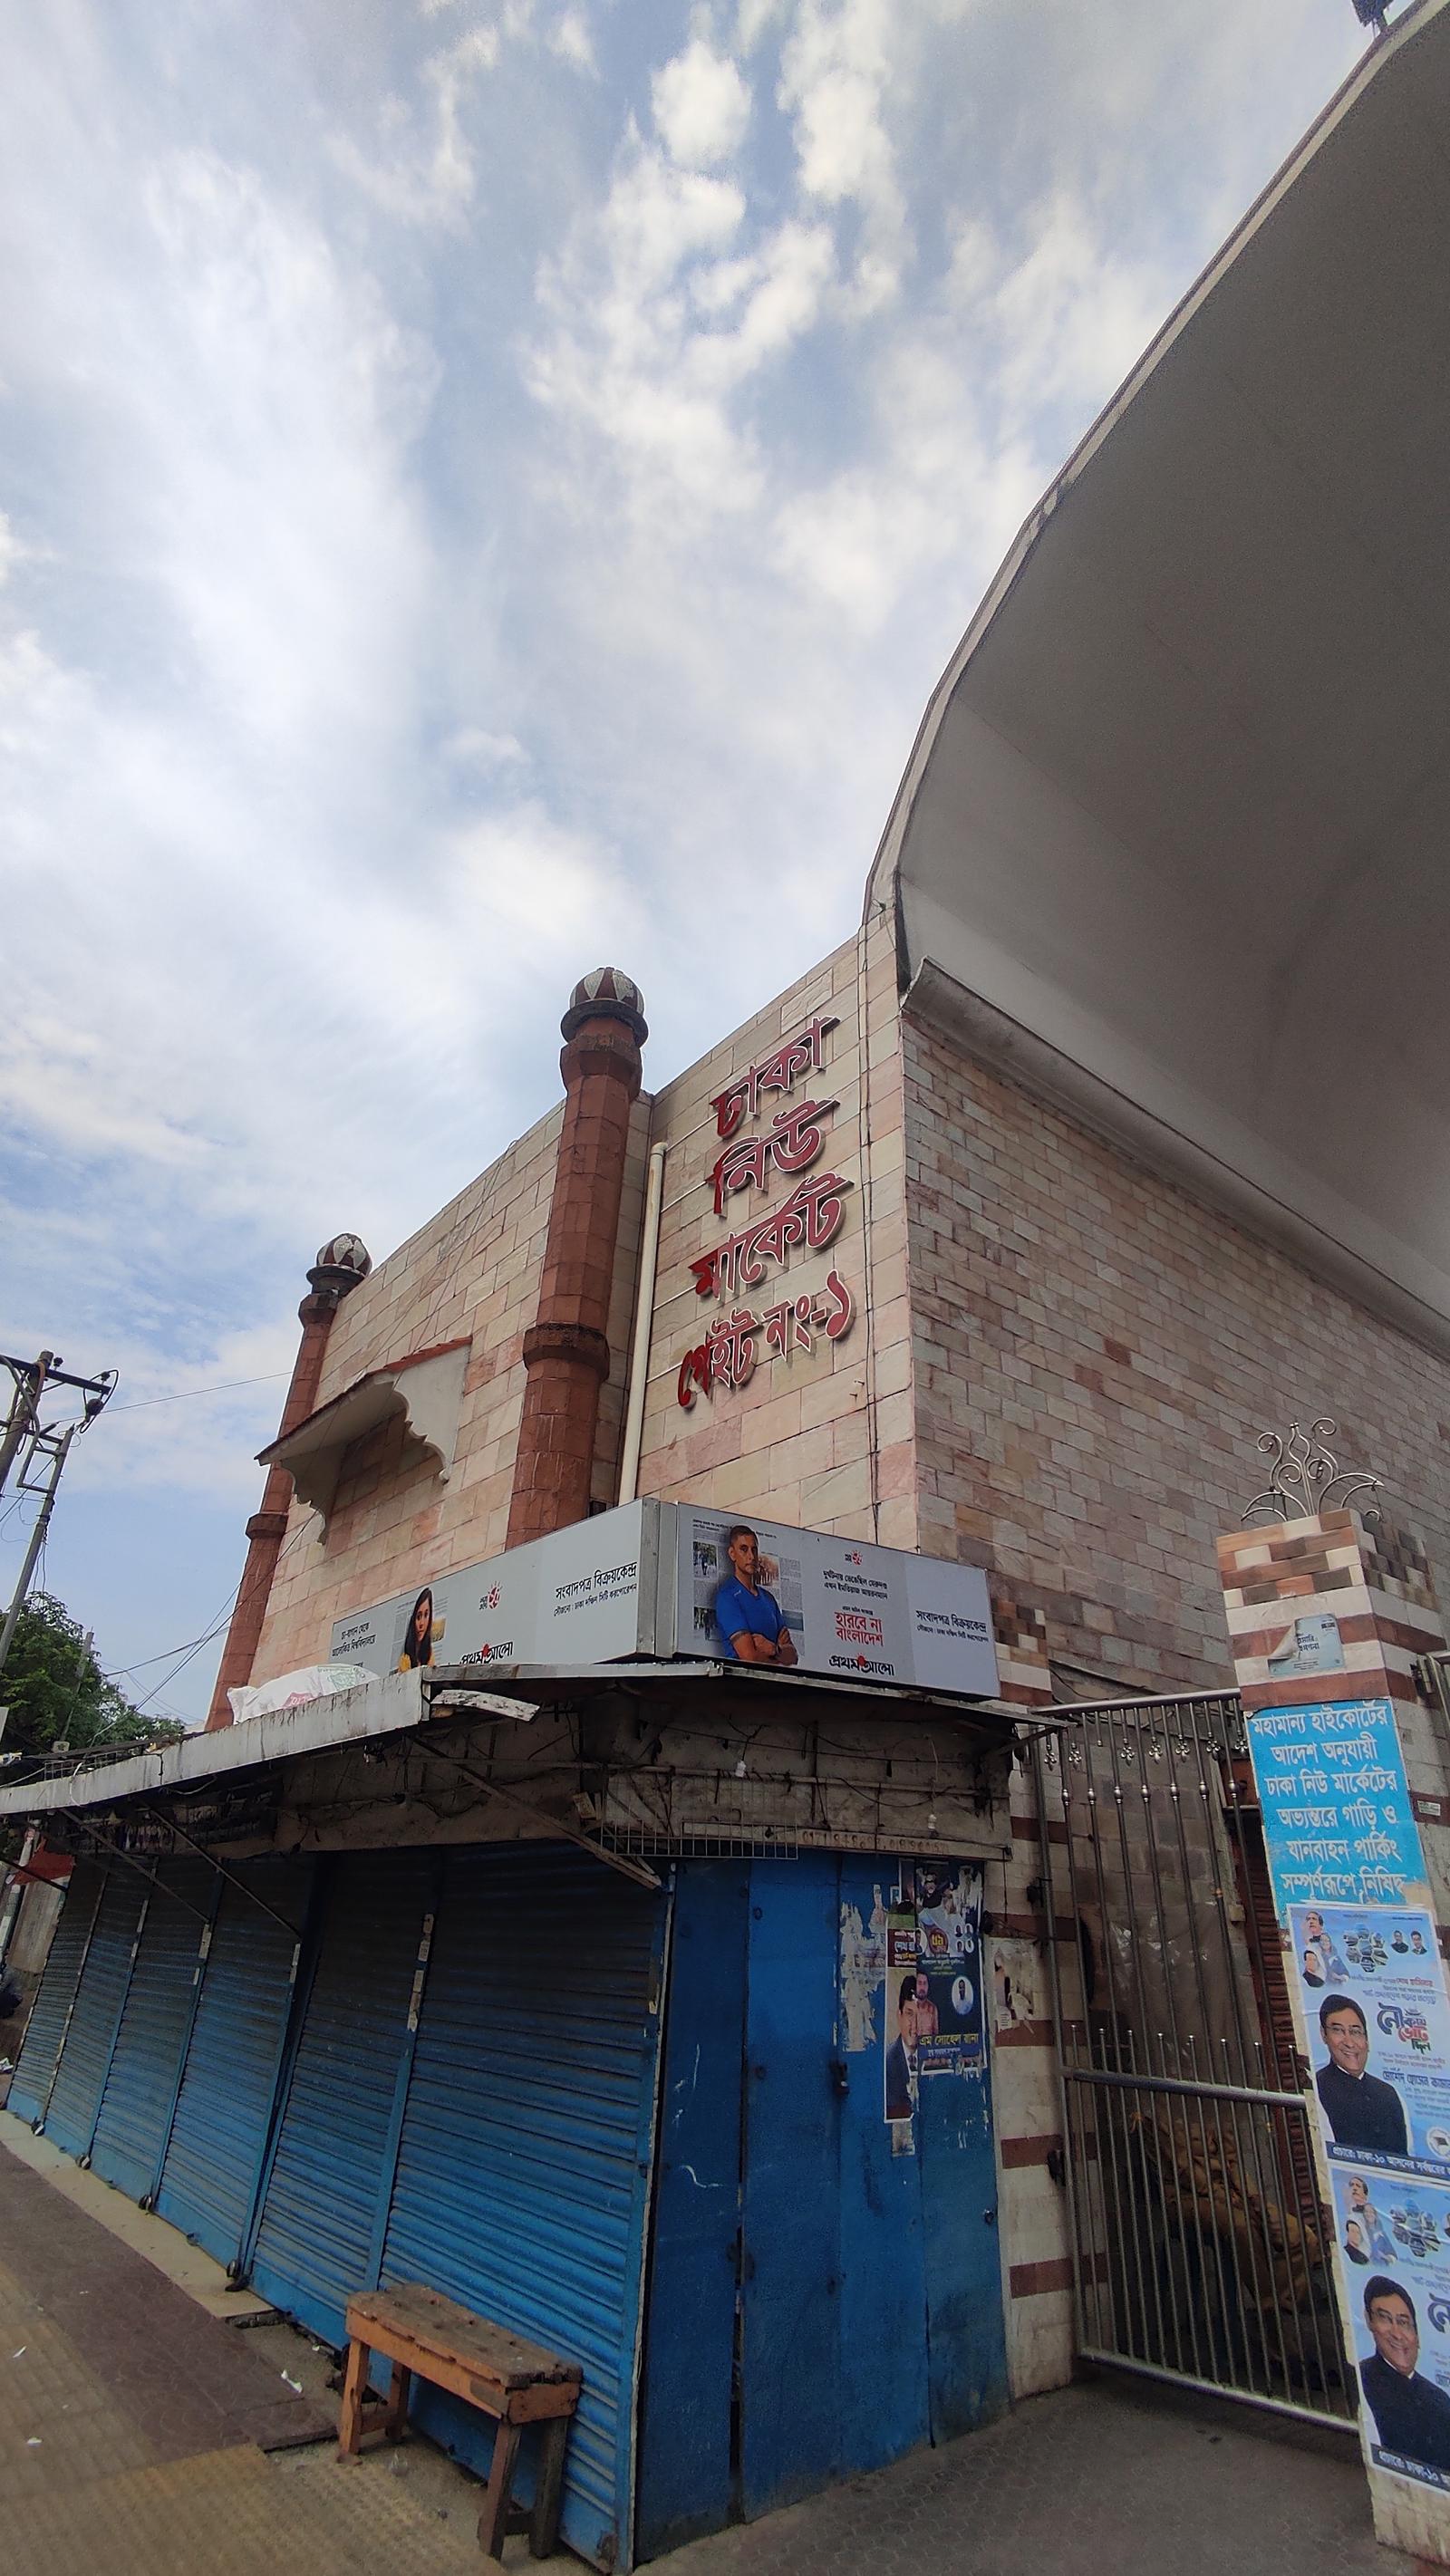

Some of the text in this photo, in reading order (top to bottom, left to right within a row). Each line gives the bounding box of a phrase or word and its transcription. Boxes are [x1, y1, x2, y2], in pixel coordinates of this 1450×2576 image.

[709, 1015, 840, 1138] ঢাকা
[706, 1098, 840, 1217] নিউ
[688, 1172, 854, 1301] মার্কেট
[677, 1307, 763, 1408] গেইট
[556, 1561, 637, 1599] সংবাদপত্র বিক্রয়কেন্দ্র
[834, 1612, 882, 1633] হারবে না
[836, 1627, 884, 1646] বাংলাদেশ
[915, 1610, 987, 1633] সংবাদপত্র বিক্রয়কেন্দ্র
[459, 1641, 513, 1664] প্রথম আলো
[829, 1655, 894, 1675] প্রথম আলো
[1251, 1699, 1388, 1739] মহামান্য হাইকোর্টের
[1271, 1732, 1378, 1767] আদেশ অনুযায়ী
[1264, 1763, 1398, 1798] ঢাকা নিউ মার্কেটের
[1276, 1807, 1339, 1829] অভ্যন্তরে
[1341, 1798, 1378, 1831] গাড়ি
[1381, 1805, 1397, 1824] ও
[1286, 1830, 1403, 1864] যানবাহন পার্কিং
[1281, 1865, 1357, 1900] সম্পূর্ণরূপে
[1398, 2026, 1429, 2042] ভোট
